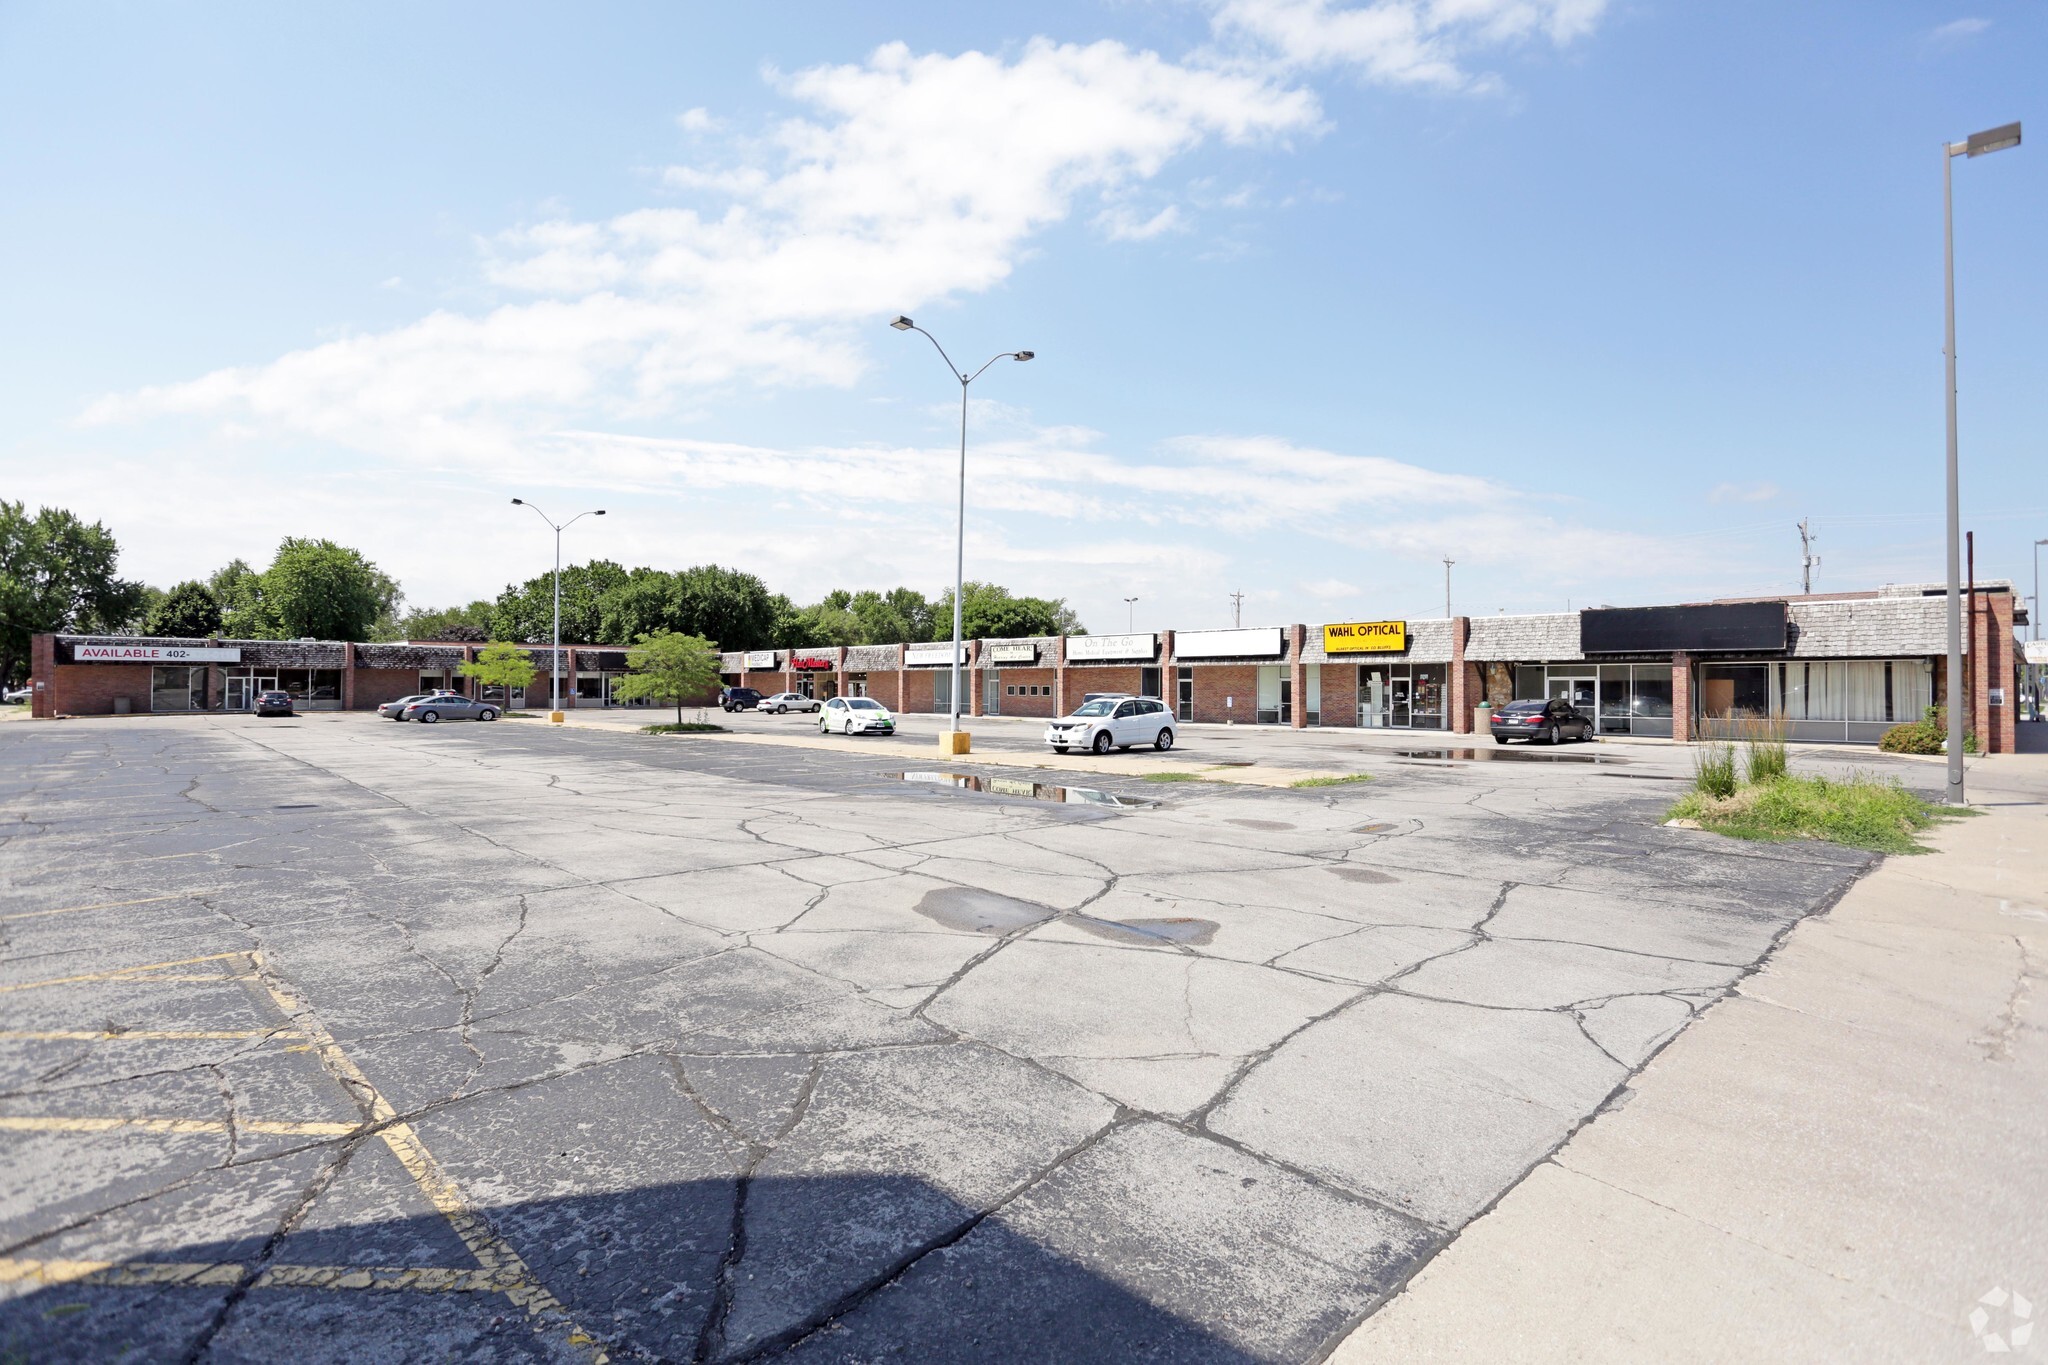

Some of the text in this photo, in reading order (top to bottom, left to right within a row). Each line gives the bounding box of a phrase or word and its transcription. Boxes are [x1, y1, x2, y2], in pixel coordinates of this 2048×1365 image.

[1328, 624, 1401, 637] WAHL OPTICAL
[1084, 636, 1134, 648] On The Go
[82, 648, 190, 658] AVAILABLE 402-
